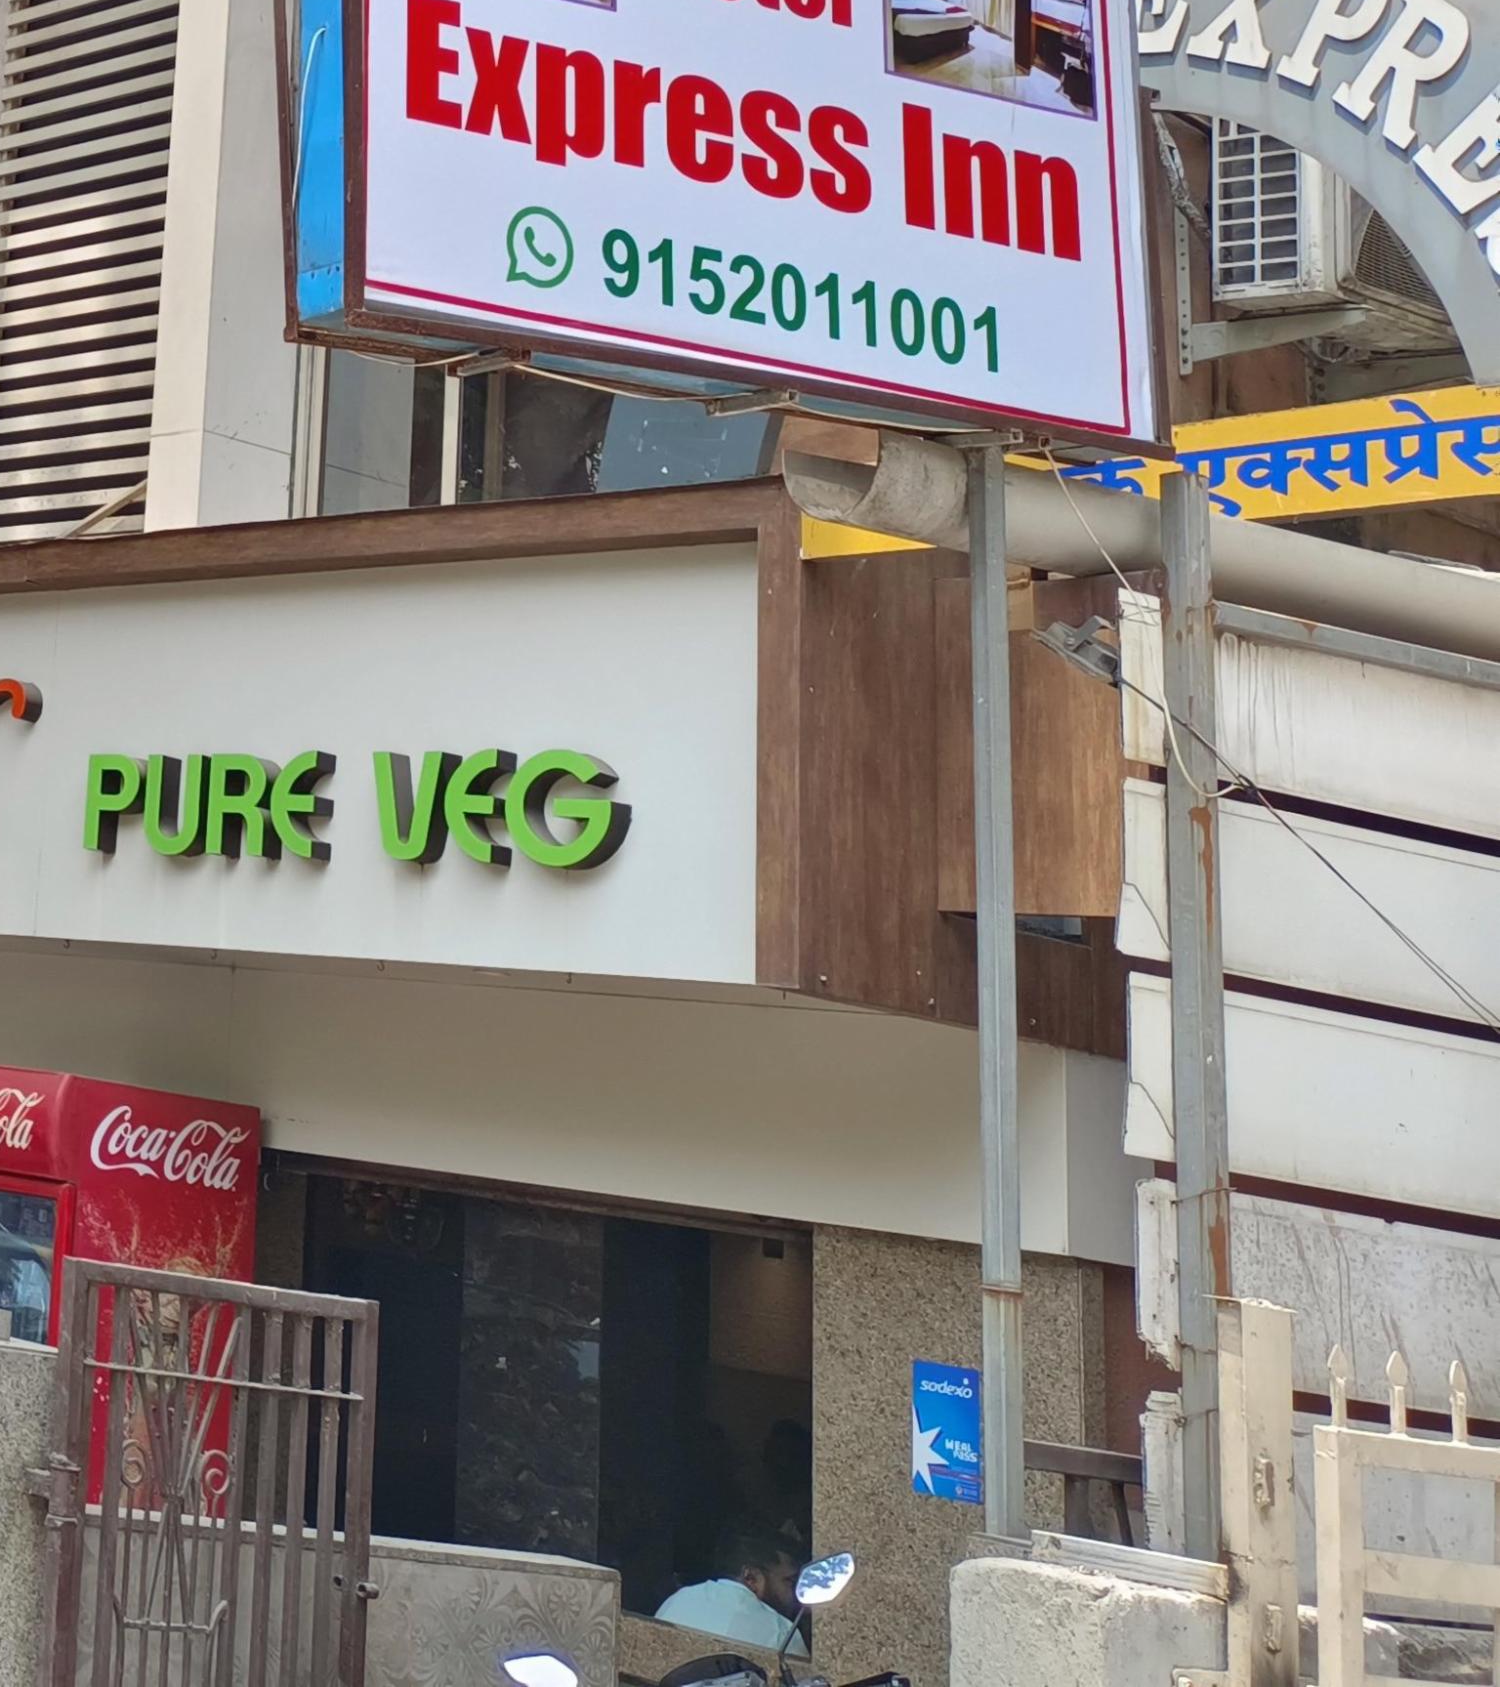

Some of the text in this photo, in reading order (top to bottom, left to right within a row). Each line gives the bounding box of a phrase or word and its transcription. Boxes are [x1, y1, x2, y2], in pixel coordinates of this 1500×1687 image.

[902, 104, 1083, 263] Inn
[601, 227, 1002, 374] 9152011001
[83, 749, 334, 864] PURE
[373, 748, 632, 871] VEG
[90, 1105, 252, 1192] Coca-Cola
[919, 1378, 974, 1399] sodexo
